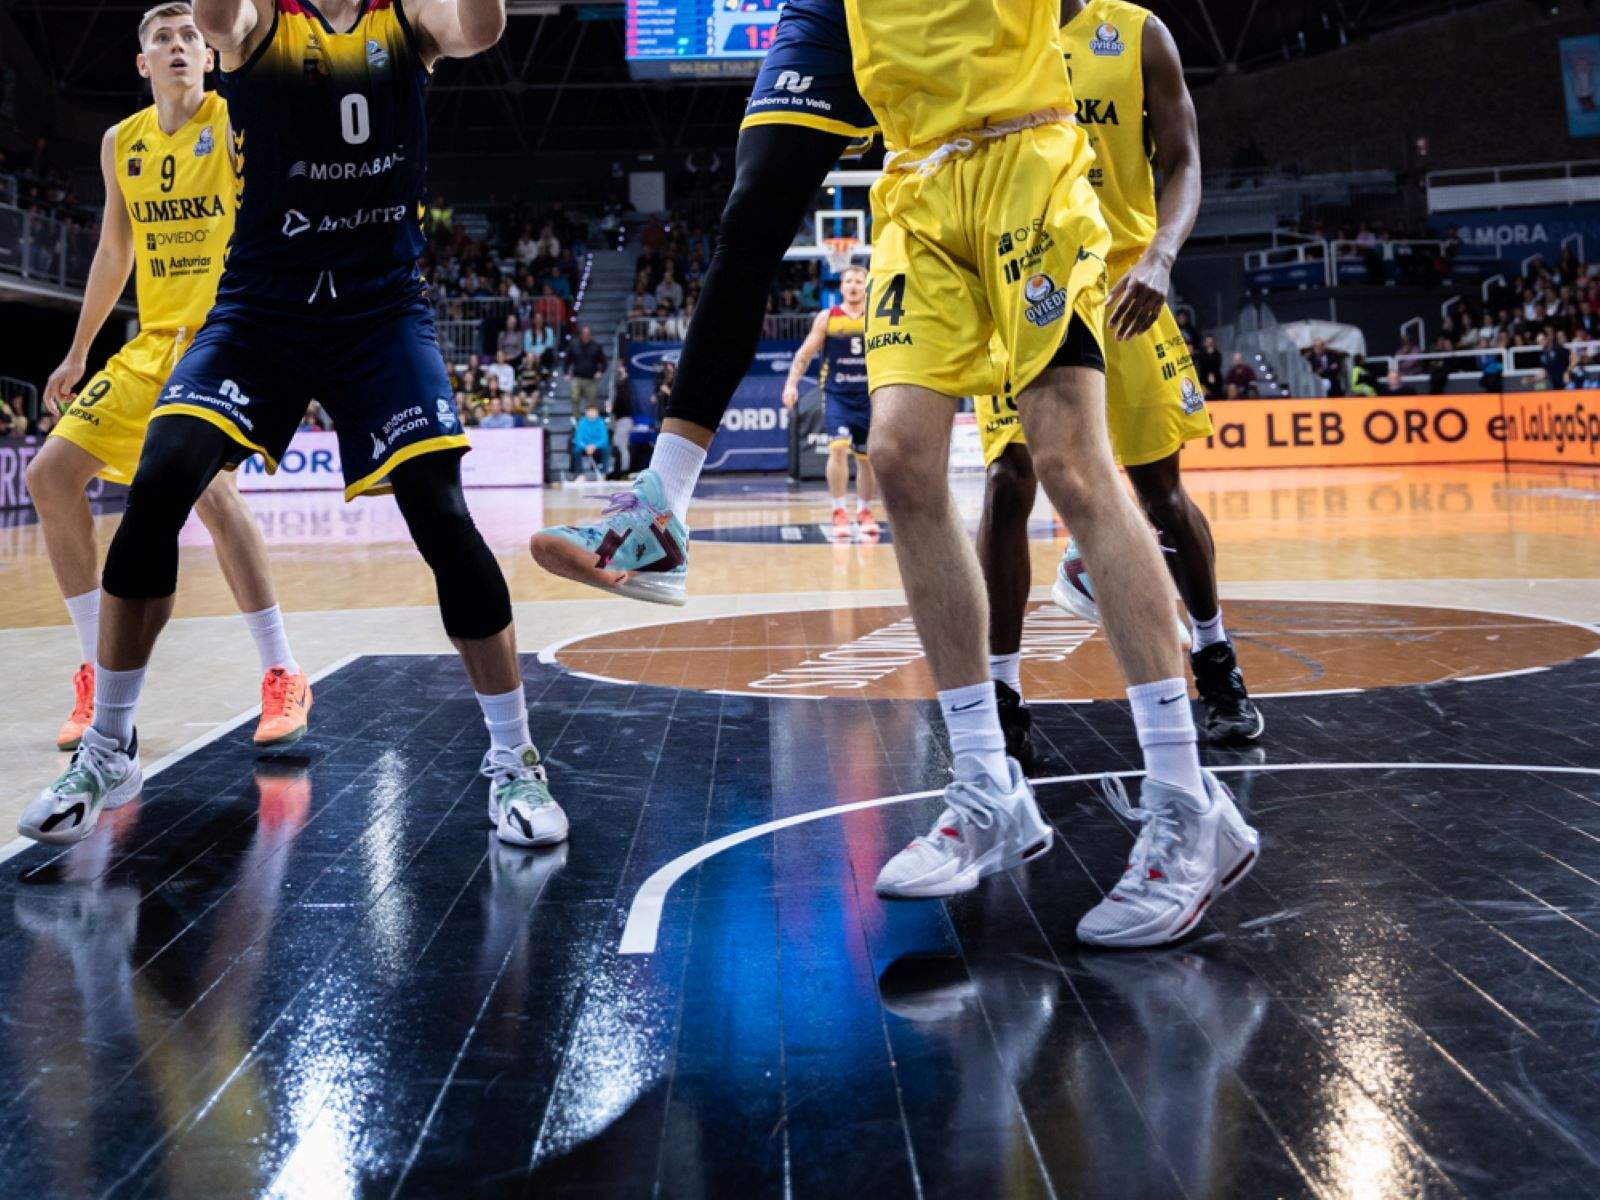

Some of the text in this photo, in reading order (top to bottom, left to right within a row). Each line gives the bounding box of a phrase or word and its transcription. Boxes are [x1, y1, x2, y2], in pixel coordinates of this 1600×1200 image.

[340, 93, 370, 145] 0
[160, 154, 176, 193] 9
[157, 229, 207, 246] OVIEDO
[169, 256, 212, 268] Asturias
[850, 335, 863, 356] 5
[79, 378, 111, 408] 9
[382, 405, 423, 435] andorra
[1266, 411, 1345, 448] LEB
[1362, 408, 1469, 445] ORO
[1486, 414, 1518, 442] en
